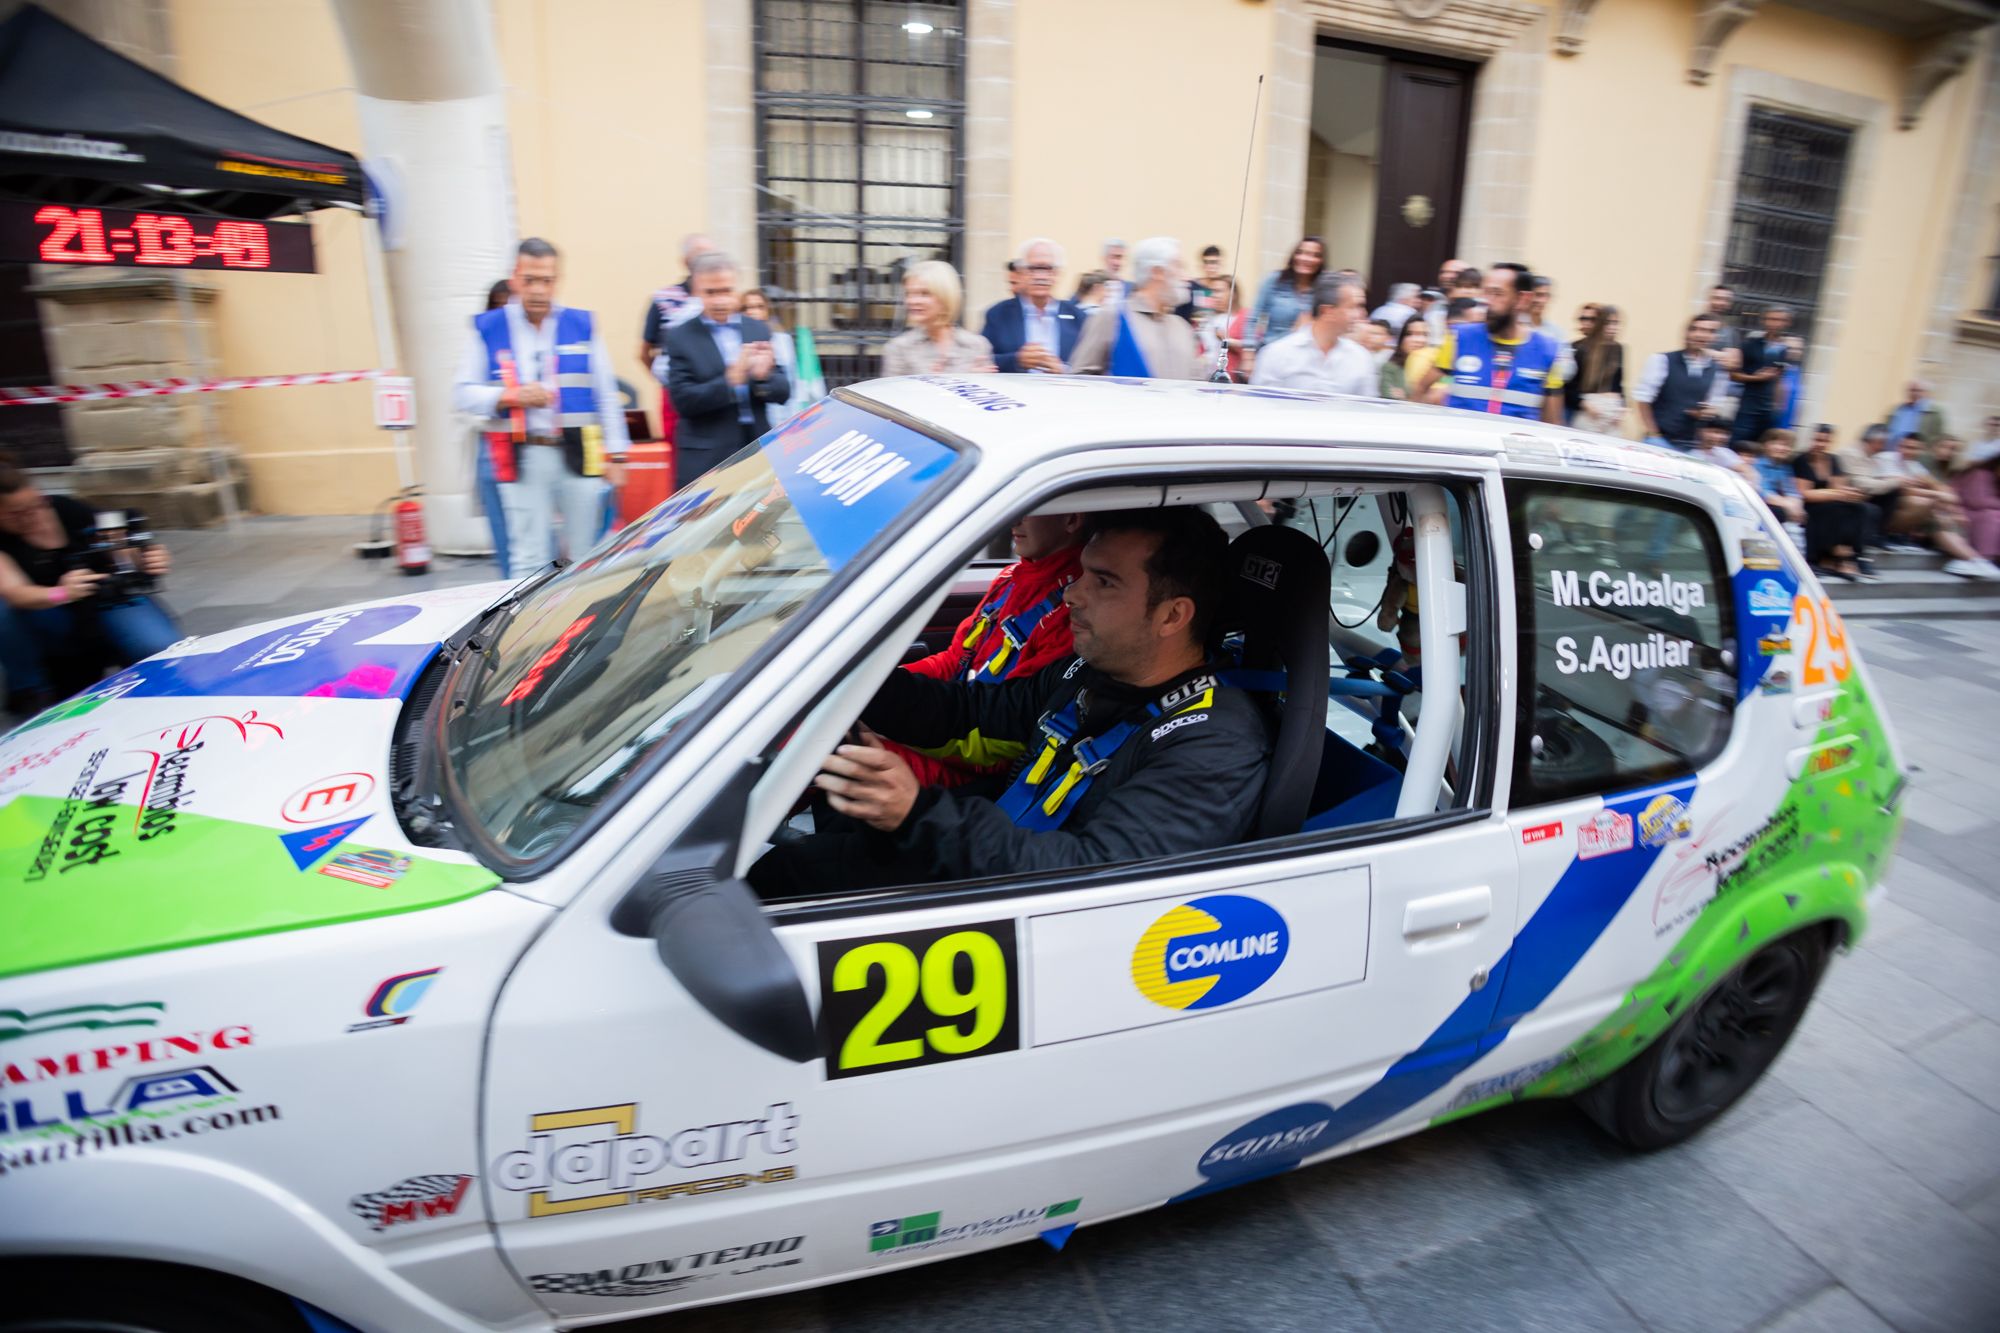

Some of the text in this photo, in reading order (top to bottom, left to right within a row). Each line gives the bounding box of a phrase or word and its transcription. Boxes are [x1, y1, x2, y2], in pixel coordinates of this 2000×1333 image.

[1550, 569, 1706, 616] M.Cabalga
[1555, 633, 1694, 681] S.Aguilar
[1793, 594, 1852, 686] 29
[1169, 930, 1279, 972] COMLINE
[832, 930, 1008, 1070] 29
[489, 1101, 801, 1192] dapart
[1200, 1119, 1331, 1167] sansa
